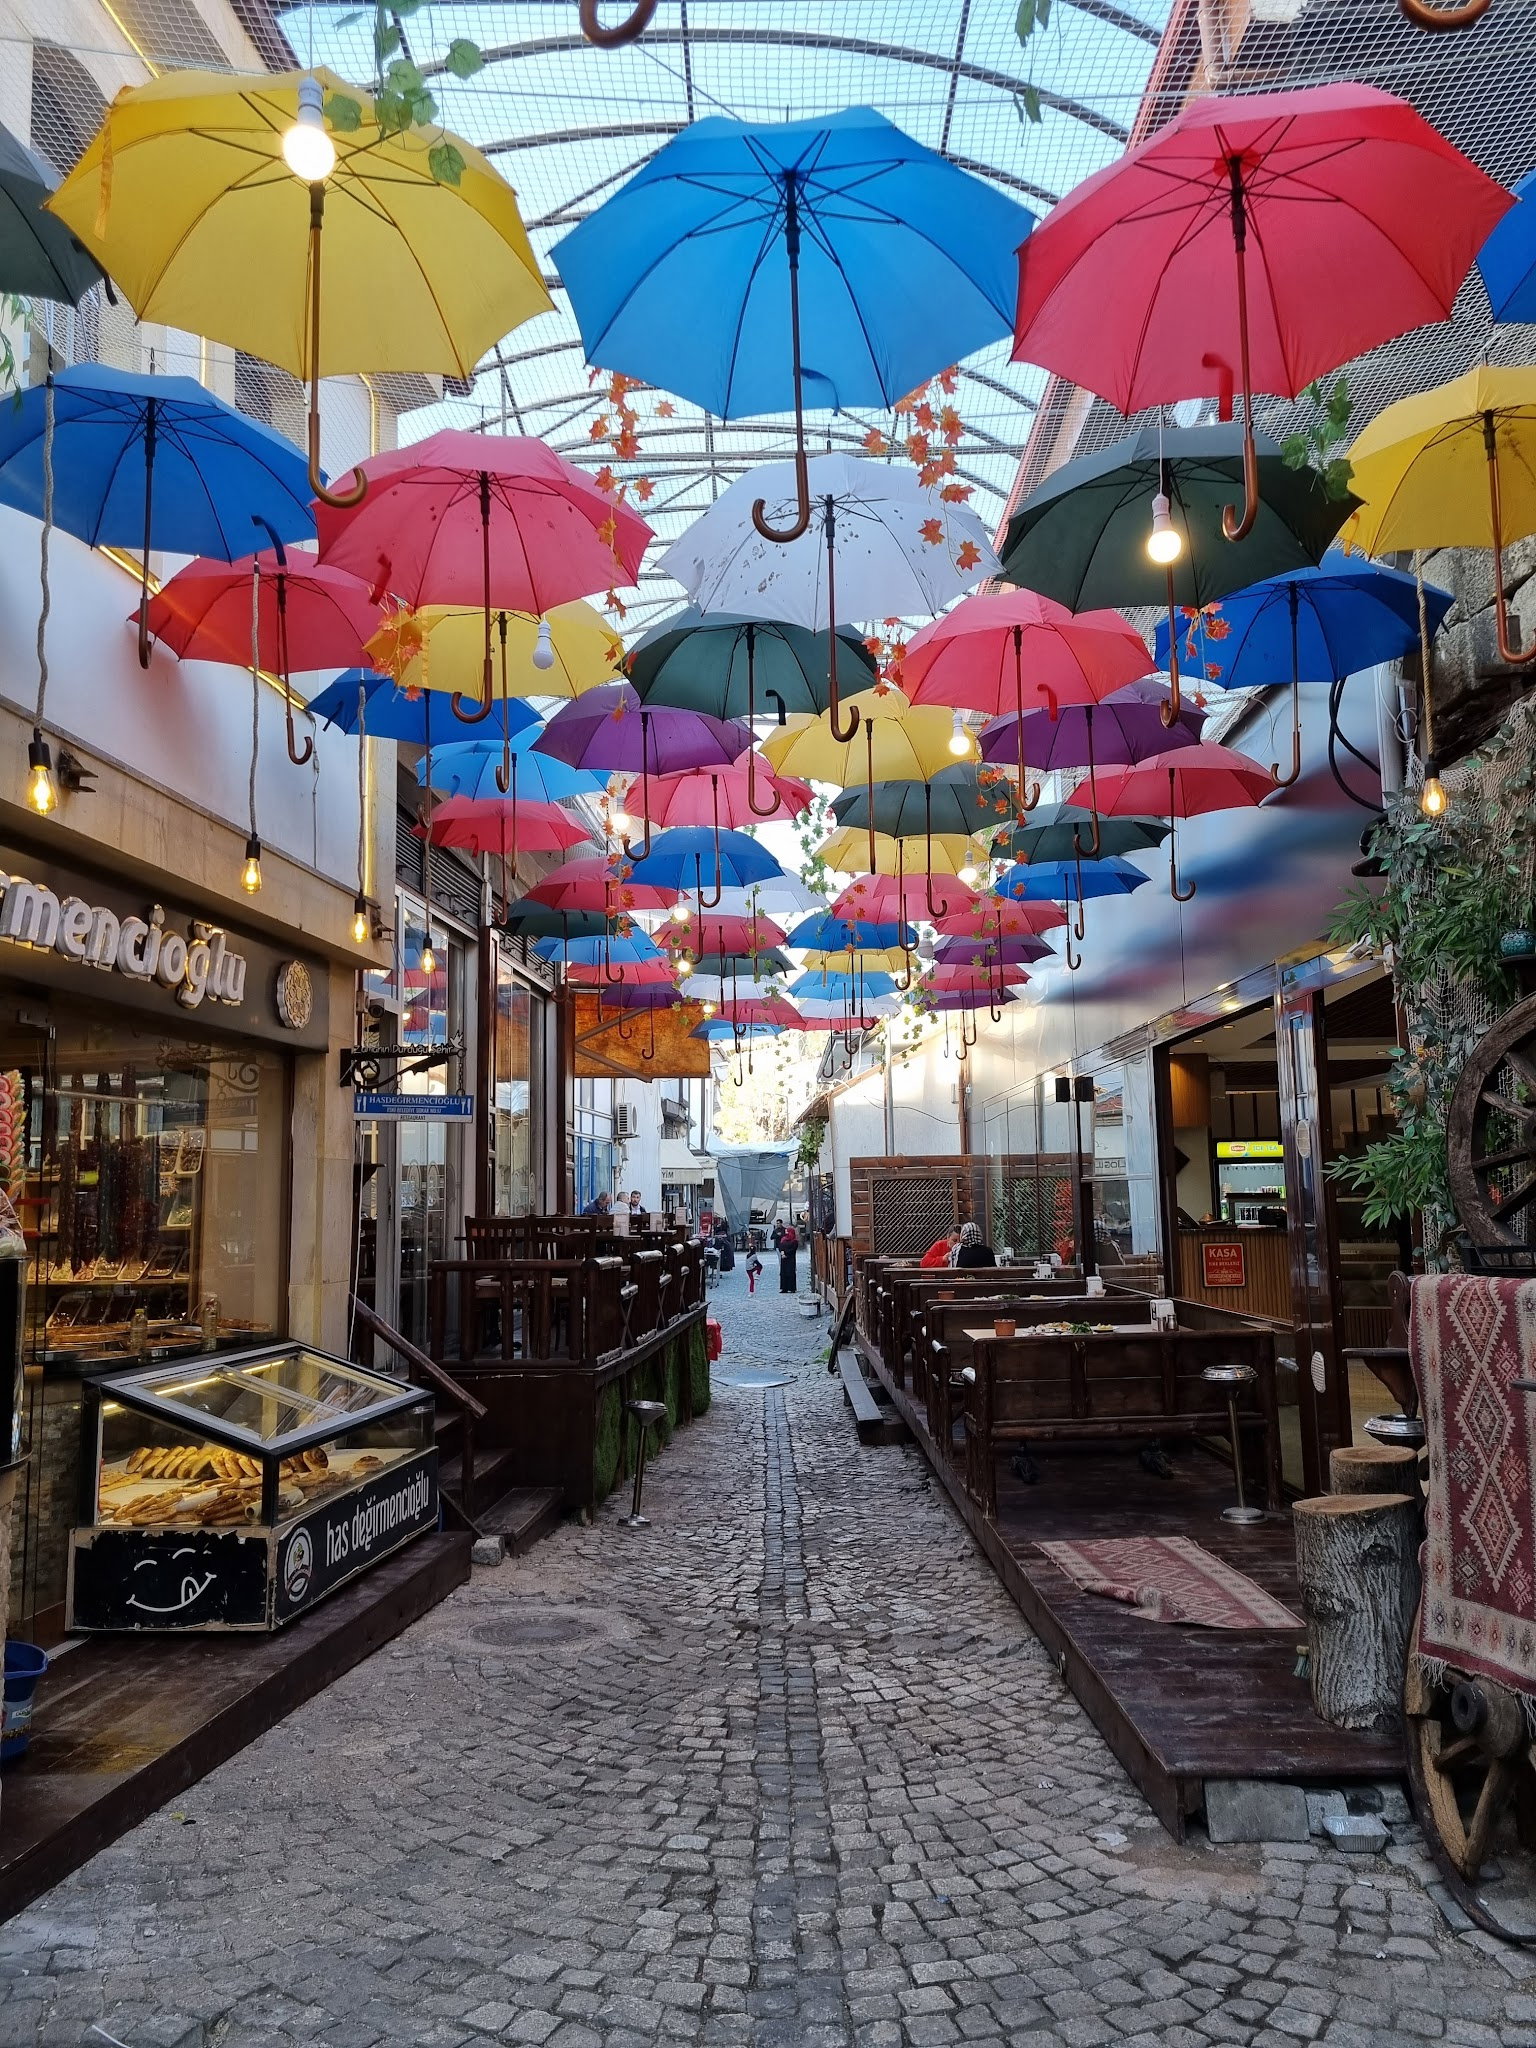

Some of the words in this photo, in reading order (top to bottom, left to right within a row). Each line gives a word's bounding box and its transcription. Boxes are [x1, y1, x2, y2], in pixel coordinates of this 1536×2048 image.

[354, 1045, 389, 1054] Zamanın
[392, 1044, 428, 1056] Durduğu
[430, 1043, 453, 1055] Şehir
[1209, 1248, 1238, 1258] KASA
[326, 1519, 349, 1567] has
[351, 1470, 429, 1551] değirmencioğlu
